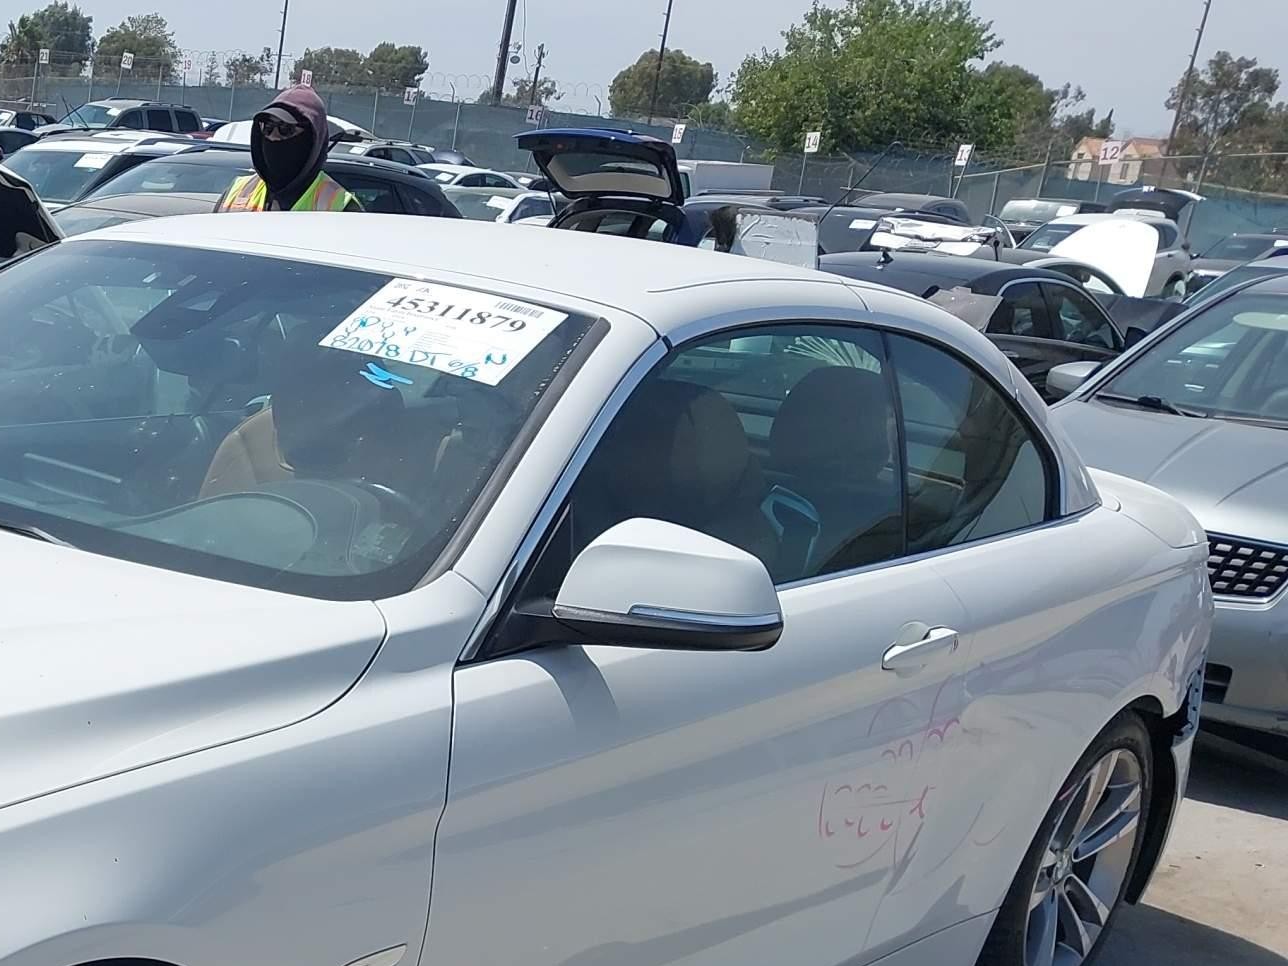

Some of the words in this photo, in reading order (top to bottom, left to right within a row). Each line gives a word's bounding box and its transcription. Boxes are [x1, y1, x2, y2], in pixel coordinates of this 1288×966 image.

[806, 136, 818, 149] 14
[1100, 146, 1120, 160] 12
[386, 295, 527, 333] 45311879
